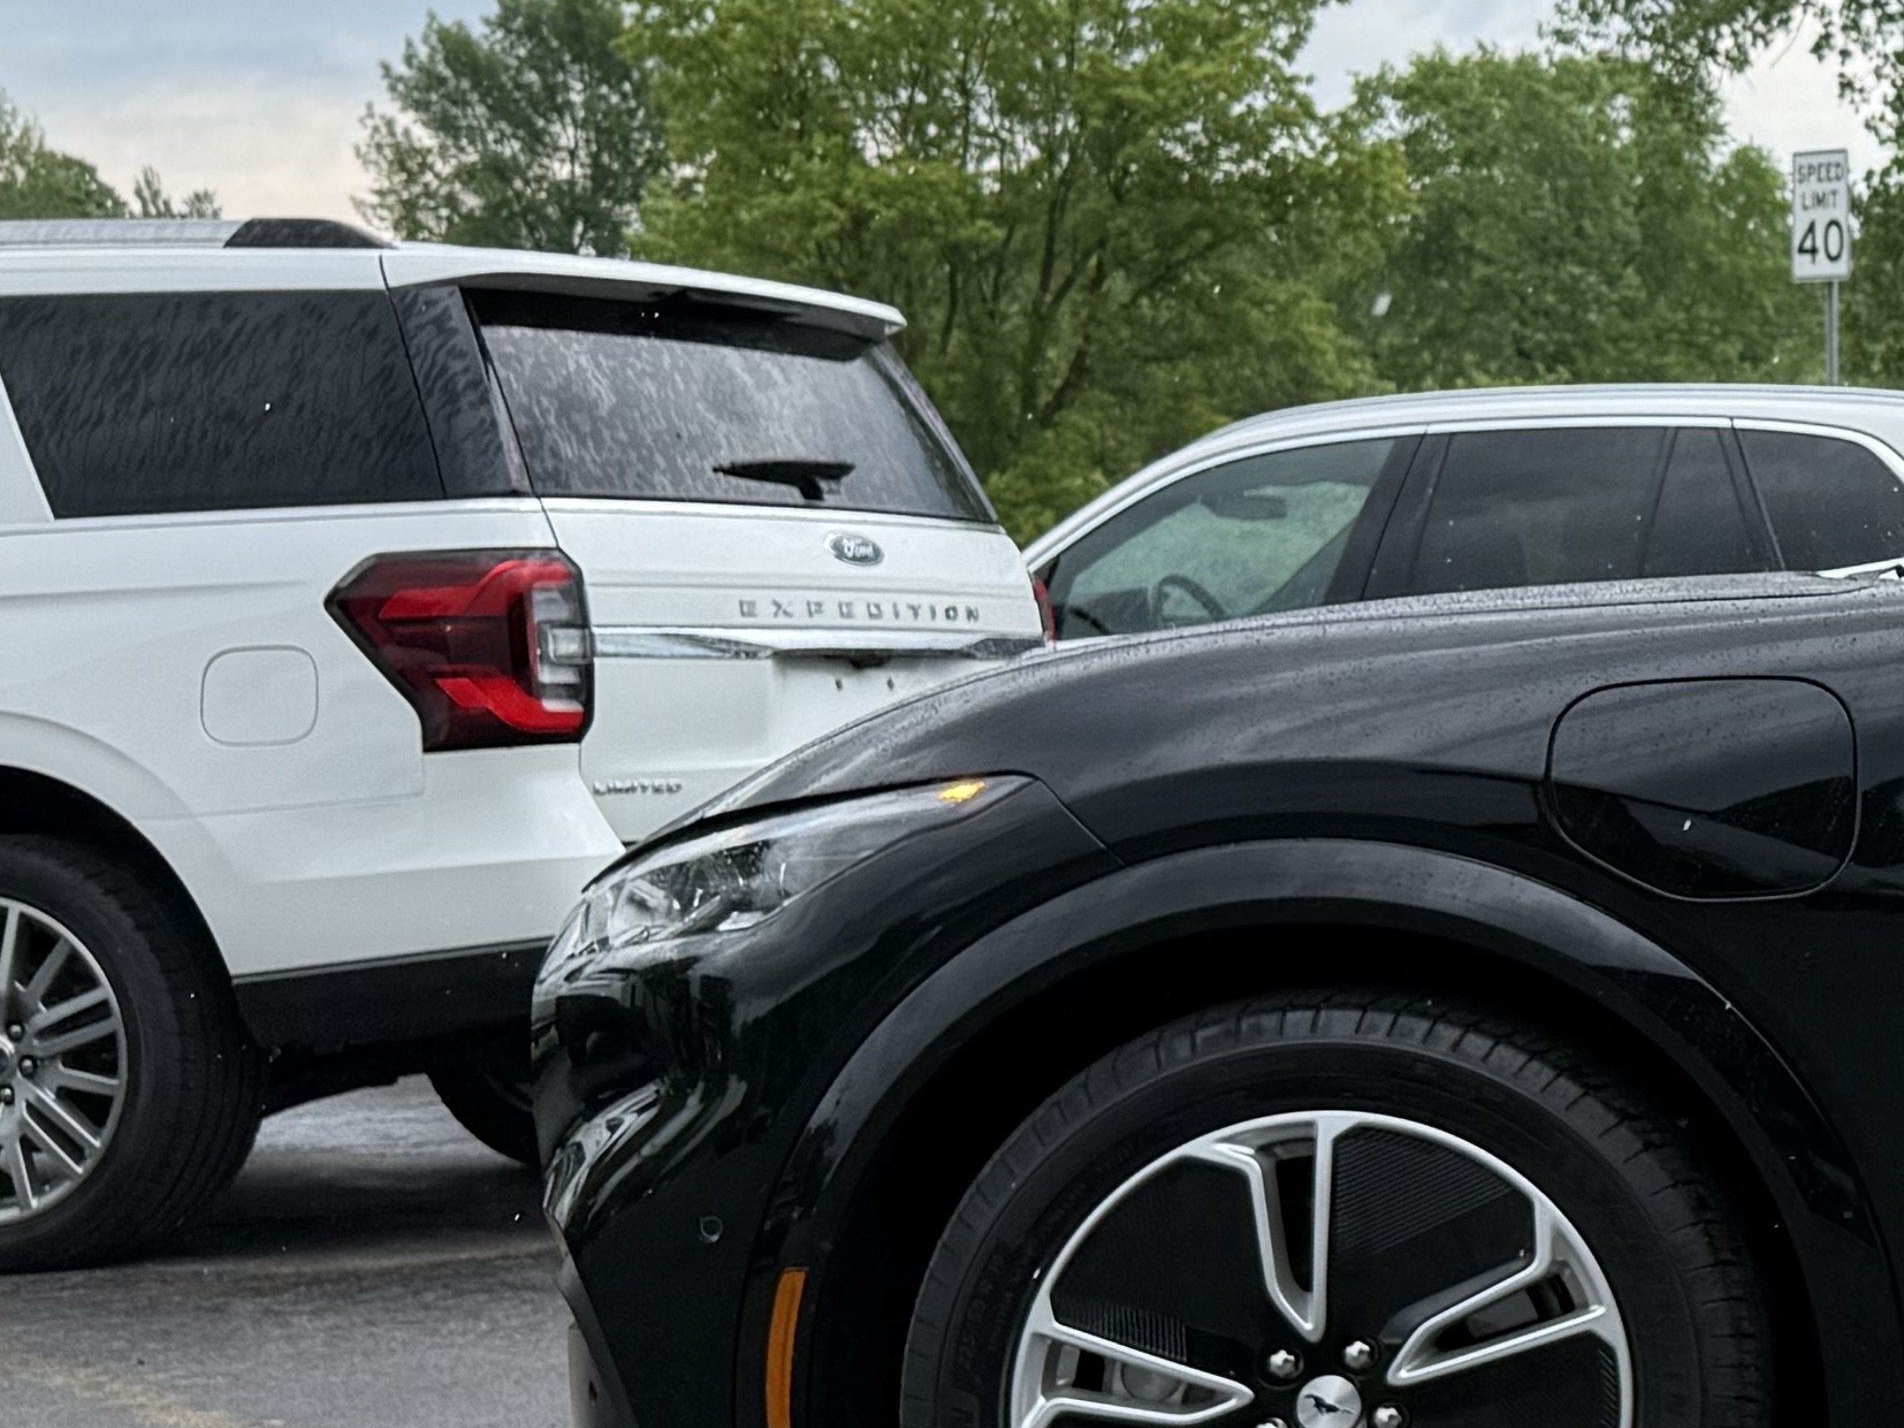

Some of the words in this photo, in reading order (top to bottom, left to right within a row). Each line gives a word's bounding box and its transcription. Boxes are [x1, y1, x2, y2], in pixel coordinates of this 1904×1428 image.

[1798, 162, 1844, 183] SPEED
[1802, 189, 1839, 210] LIMIT
[1797, 219, 1844, 263] 40
[738, 598, 981, 623] EXPEDITION
[592, 779, 683, 796] LIMITED
